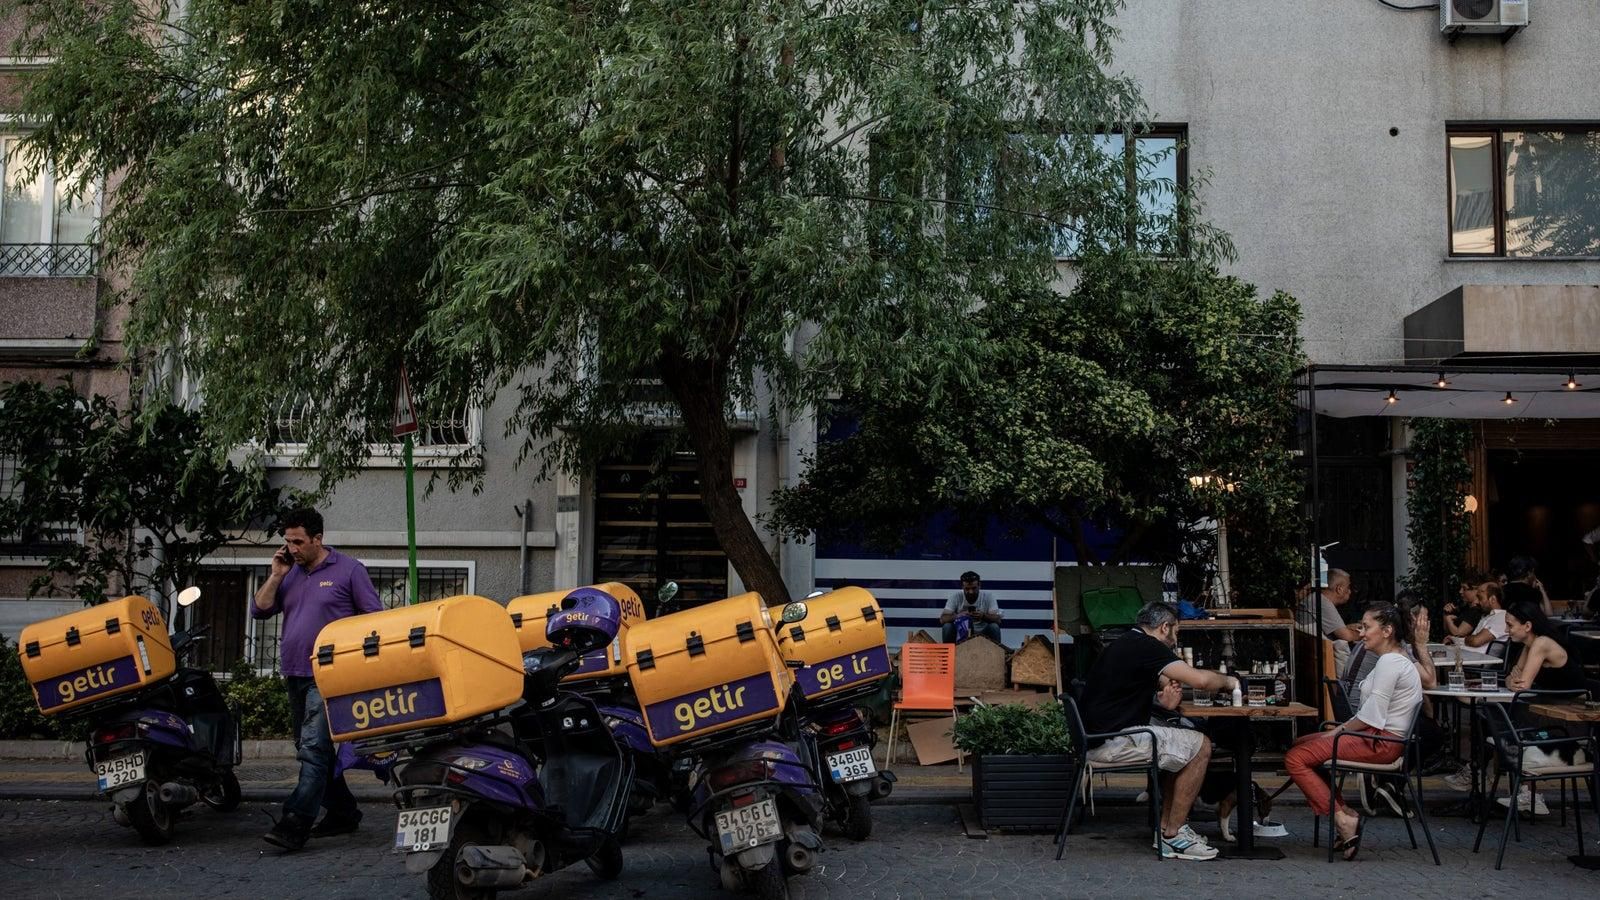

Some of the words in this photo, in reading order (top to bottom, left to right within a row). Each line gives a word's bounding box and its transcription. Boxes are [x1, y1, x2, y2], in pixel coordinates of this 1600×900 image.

[319, 580, 334, 588] getir
[566, 612, 590, 623] getir
[621, 596, 641, 621] getir
[141, 606, 160, 631] getir
[58, 666, 115, 703] getir
[352, 687, 418, 729] getir
[674, 684, 746, 731] getir
[98, 754, 144, 776] 34BHD
[831, 750, 870, 768] 34BUD
[113, 769, 137, 785] 320
[844, 762, 868, 777] 365
[399, 809, 450, 828] 34CGC
[413, 826, 437, 843] 181
[736, 822, 765, 842] 026
